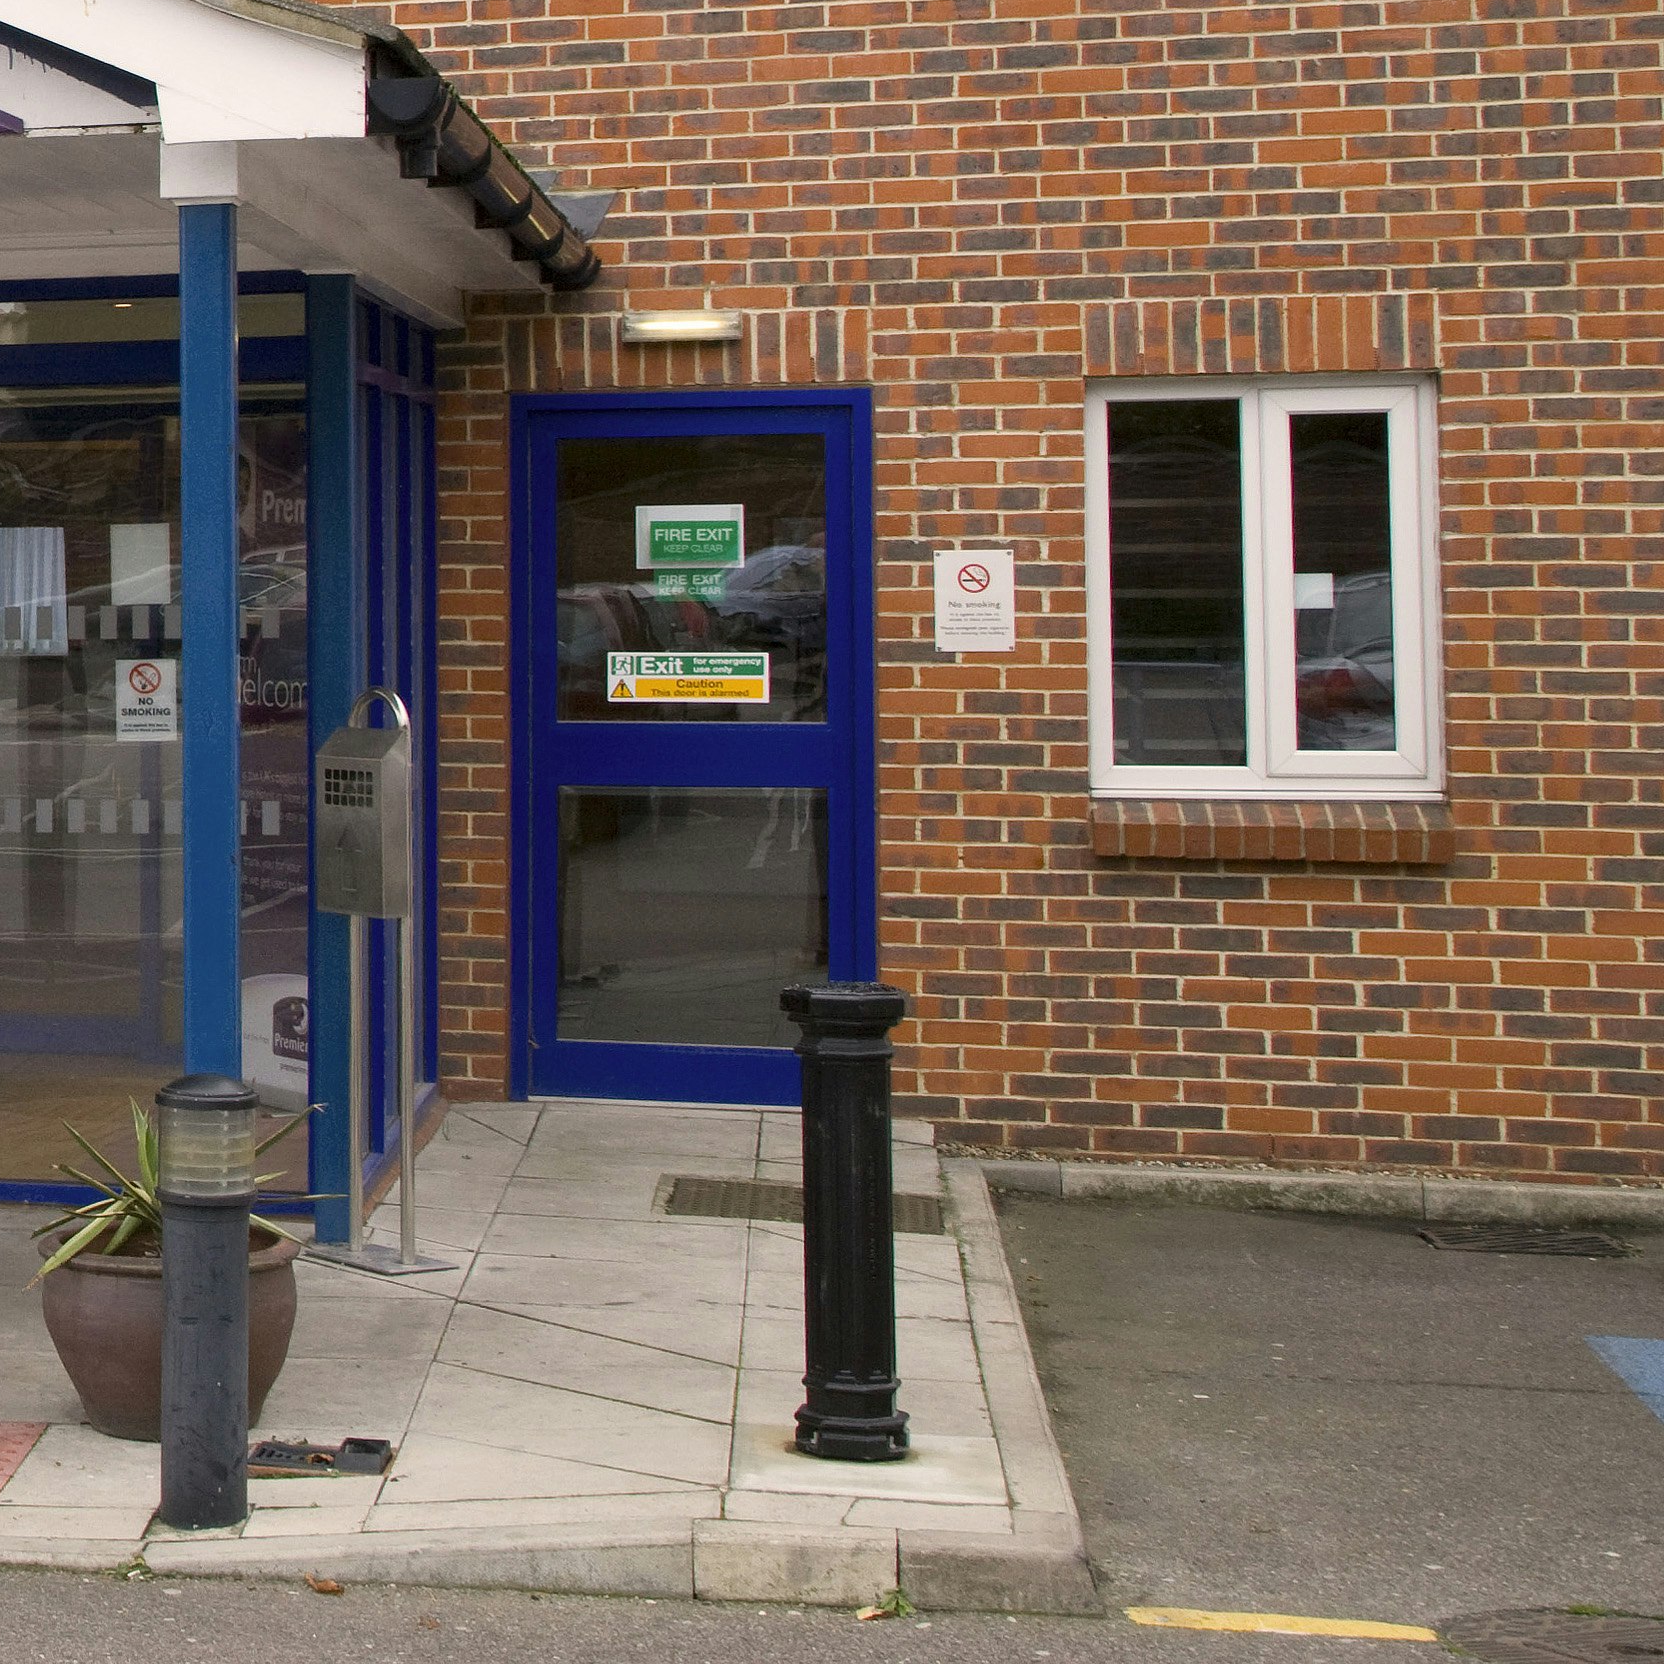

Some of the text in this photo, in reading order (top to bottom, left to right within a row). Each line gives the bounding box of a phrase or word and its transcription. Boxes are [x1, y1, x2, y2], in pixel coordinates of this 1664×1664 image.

[655, 528, 733, 541] FIRE EXIT
[659, 574, 722, 585] FIRE EXIT
[640, 658, 683, 675] Exit
[693, 657, 762, 667] for emergency
[712, 666, 733, 674] only
[676, 679, 723, 689] Caution
[651, 689, 670, 697] This
[673, 689, 696, 697] door
[709, 689, 749, 697] alarmed
[121, 708, 171, 716] SMOKING
